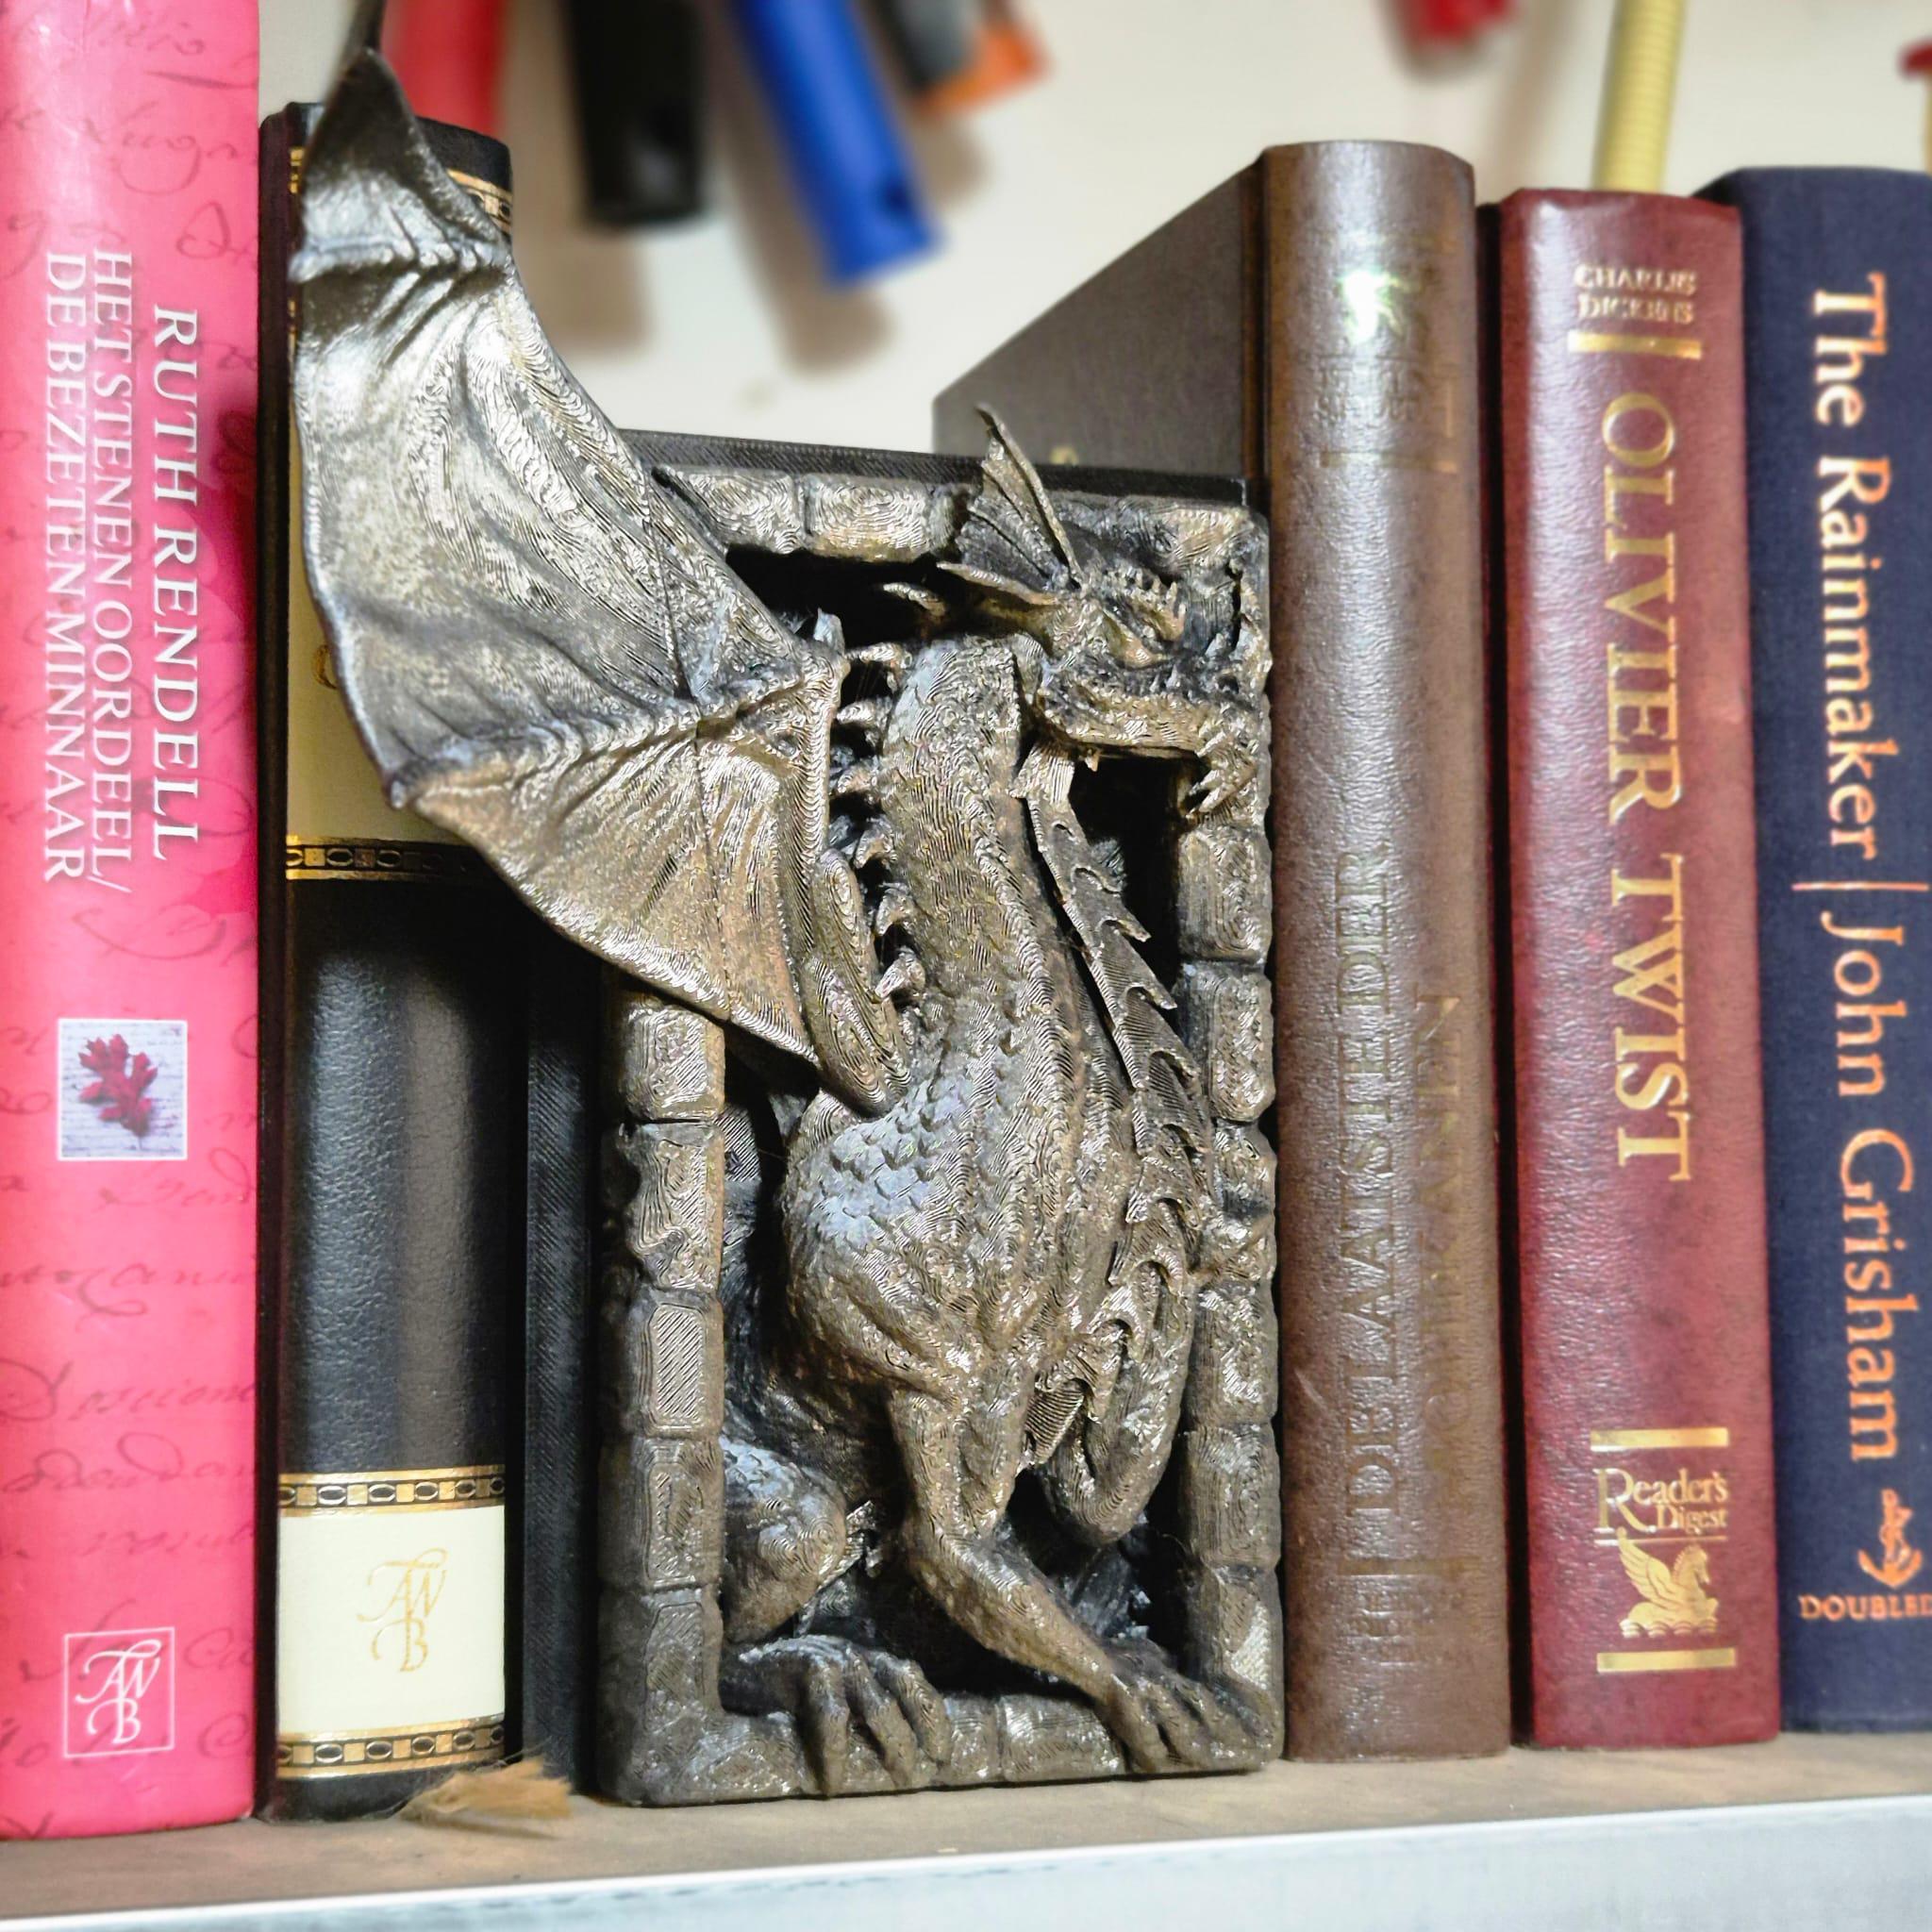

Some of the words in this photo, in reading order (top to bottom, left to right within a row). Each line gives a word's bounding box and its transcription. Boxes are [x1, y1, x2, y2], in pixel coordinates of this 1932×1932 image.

[46, 251, 87, 327] DE
[94, 250, 132, 366] HET
[154, 303, 198, 508] RUTH
[1813, 270, 1887, 427] The
[45, 337, 87, 598] BEZETEN
[94, 371, 133, 589] STENEN
[153, 523, 198, 860] RENDELL
[1602, 391, 1683, 826] OLIVIER
[1819, 457, 1898, 860] Rainmaker
[43, 610, 87, 883] MINNAAR
[87, 599, 133, 892] OORDEEL/
[1610, 852, 1691, 1182] TWIST
[1820, 909, 1907, 1096] John
[1840, 1128, 1919, 1461] Grisham
[1592, 1468, 1728, 1533] Reader's
[1656, 1504, 1728, 1535] Digest
